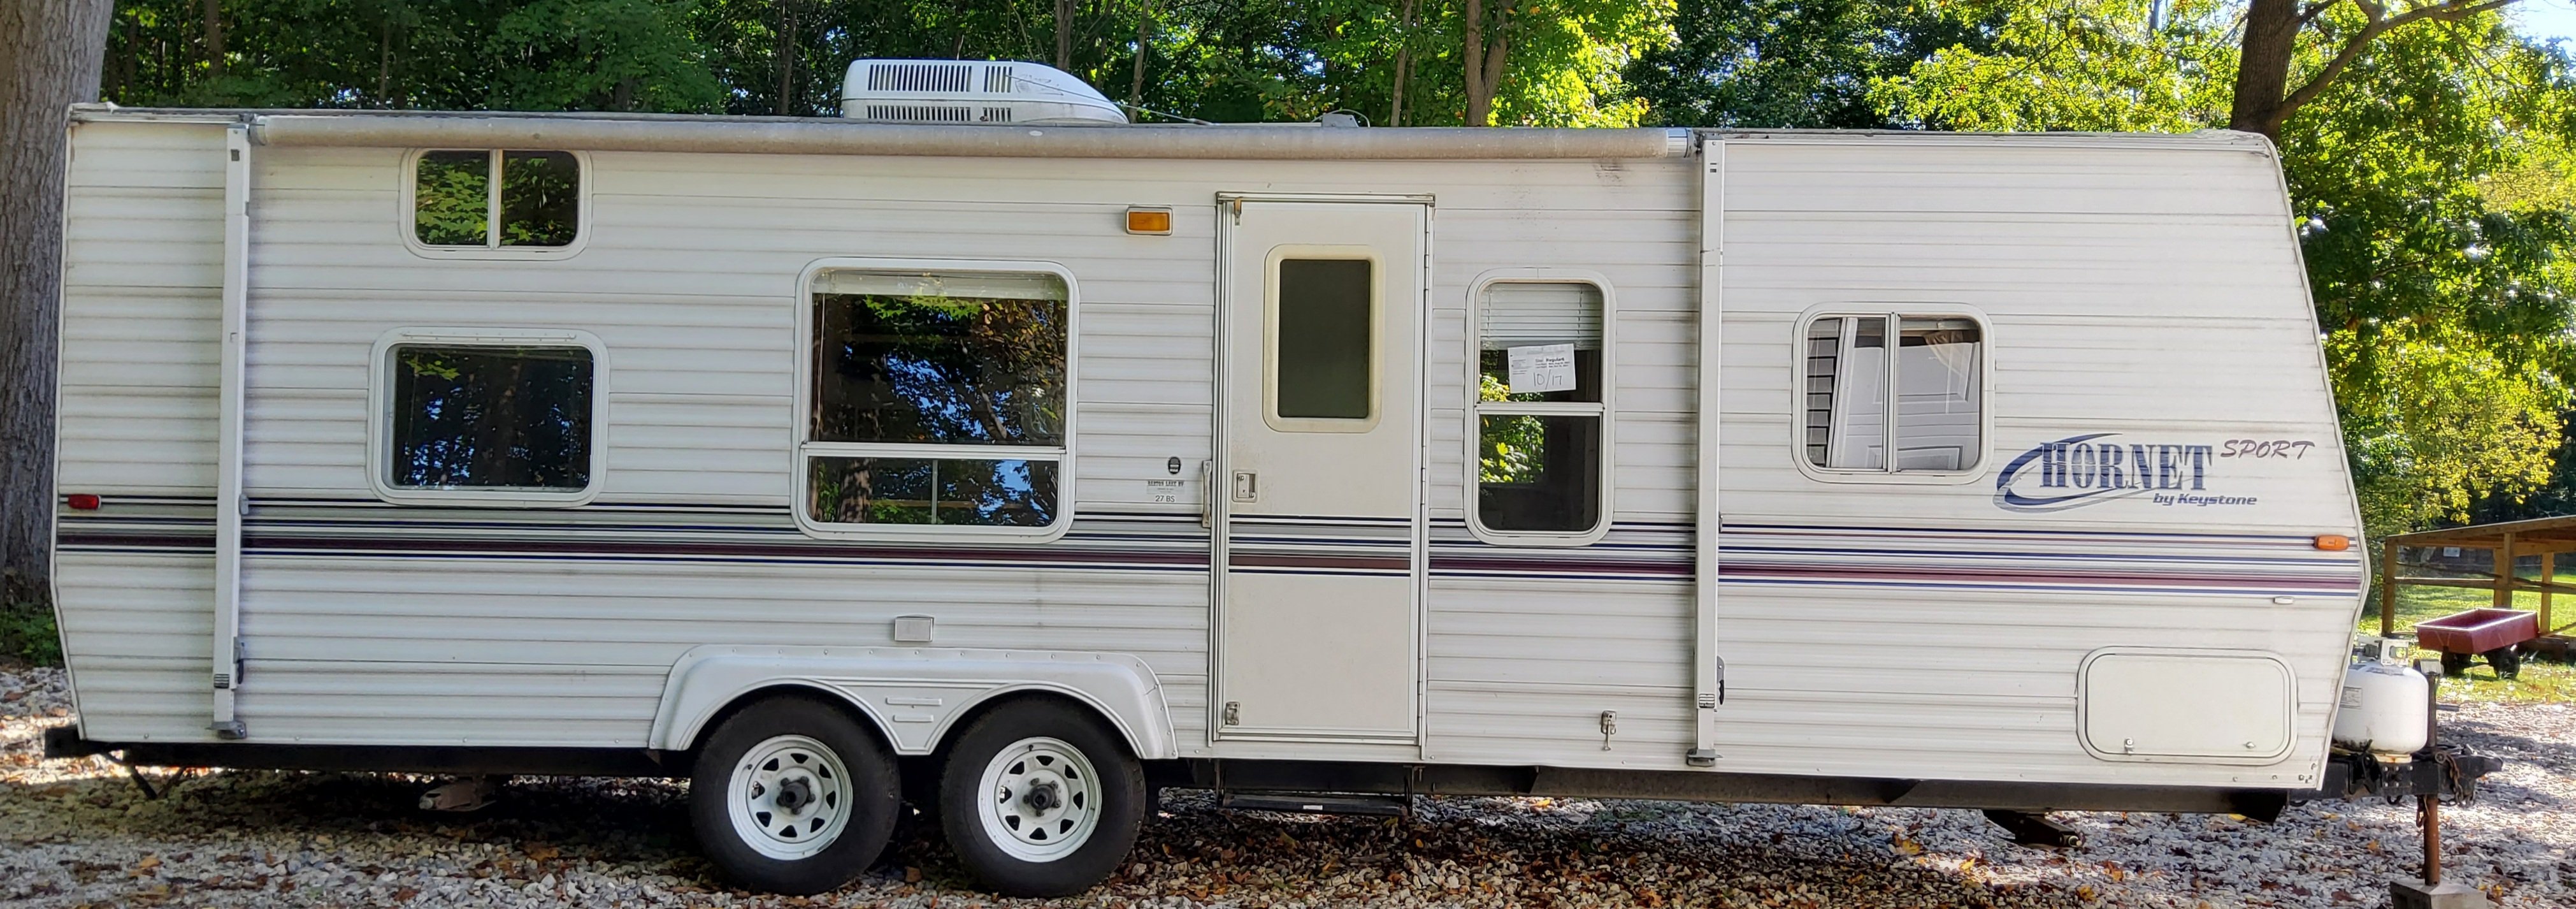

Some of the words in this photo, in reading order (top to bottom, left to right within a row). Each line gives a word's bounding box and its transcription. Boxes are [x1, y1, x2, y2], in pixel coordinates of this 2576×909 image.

[1533, 369, 1562, 390] 10/17
[2039, 442, 2213, 490] HORNET
[2220, 439, 2315, 460] SPORT
[2152, 493, 2174, 506] by
[2177, 493, 2257, 507] Keystone
